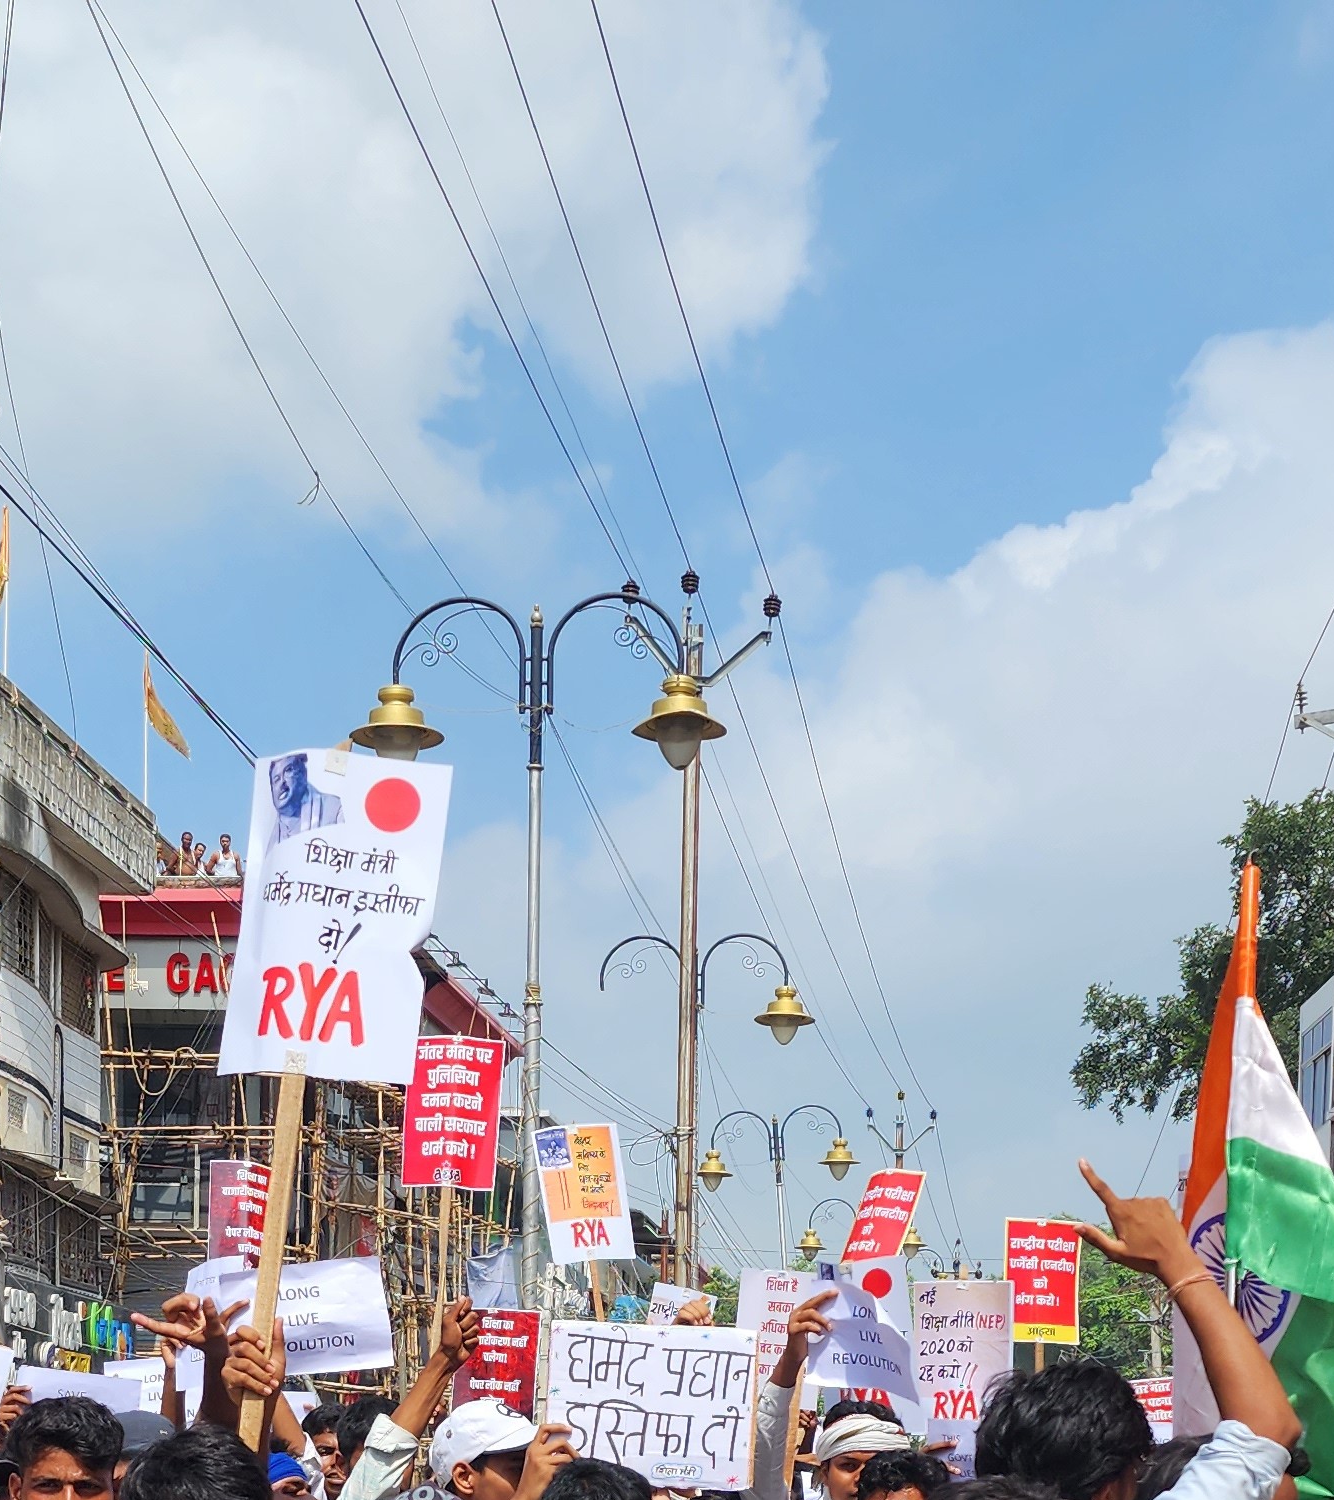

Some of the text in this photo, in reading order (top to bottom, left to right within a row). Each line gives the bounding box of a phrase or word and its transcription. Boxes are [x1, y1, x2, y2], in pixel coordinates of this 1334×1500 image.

[305, 838, 399, 874] शिक्षा मंत्री
[296, 880, 355, 910] प्रधान
[354, 884, 425, 916] इस्तीफा
[258, 962, 365, 1047] RYA
[417, 1042, 494, 1063] जंतर मंतर पर
[427, 1064, 480, 1088] पुलिसिया
[421, 1092, 483, 1111] दमन करने
[415, 1113, 487, 1136] वाली सरकार
[422, 1136, 444, 1156] शर्म
[884, 1186, 916, 1203] परीक्षा
[225, 1228, 242, 1239] पेपर
[571, 1220, 610, 1247] RYA
[861, 1222, 874, 1235] को
[1010, 1236, 1075, 1252] राष्ट्रीय परीक्षा
[1009, 1256, 1039, 1270] एजेंसी
[766, 1278, 799, 1292] शिक्षा है
[1033, 1276, 1048, 1289] को
[278, 1286, 320, 1301] LONG
[919, 1286, 937, 1307] नई
[1015, 1292, 1033, 1305] भंग
[768, 1301, 795, 1312] सबका
[853, 1305, 877, 1322] LON
[288, 1312, 319, 1327] LIVE
[482, 1317, 514, 1331] शिक्षा का
[761, 1320, 788, 1334] अधिका
[920, 1310, 1006, 1332] शिक्षा नीति (NEP)
[286, 1335, 355, 1352] OLUTION
[512, 1336, 529, 1347] नहीं
[859, 1330, 883, 1345] LIVE
[920, 1336, 974, 1356] 2020 को
[833, 1353, 902, 1376] REVOLUTION
[144, 1375, 164, 1383] LON
[470, 1377, 521, 1392] पेपर लीक नहीं
[148, 1393, 162, 1401] LIV
[934, 1389, 979, 1420] RYA
